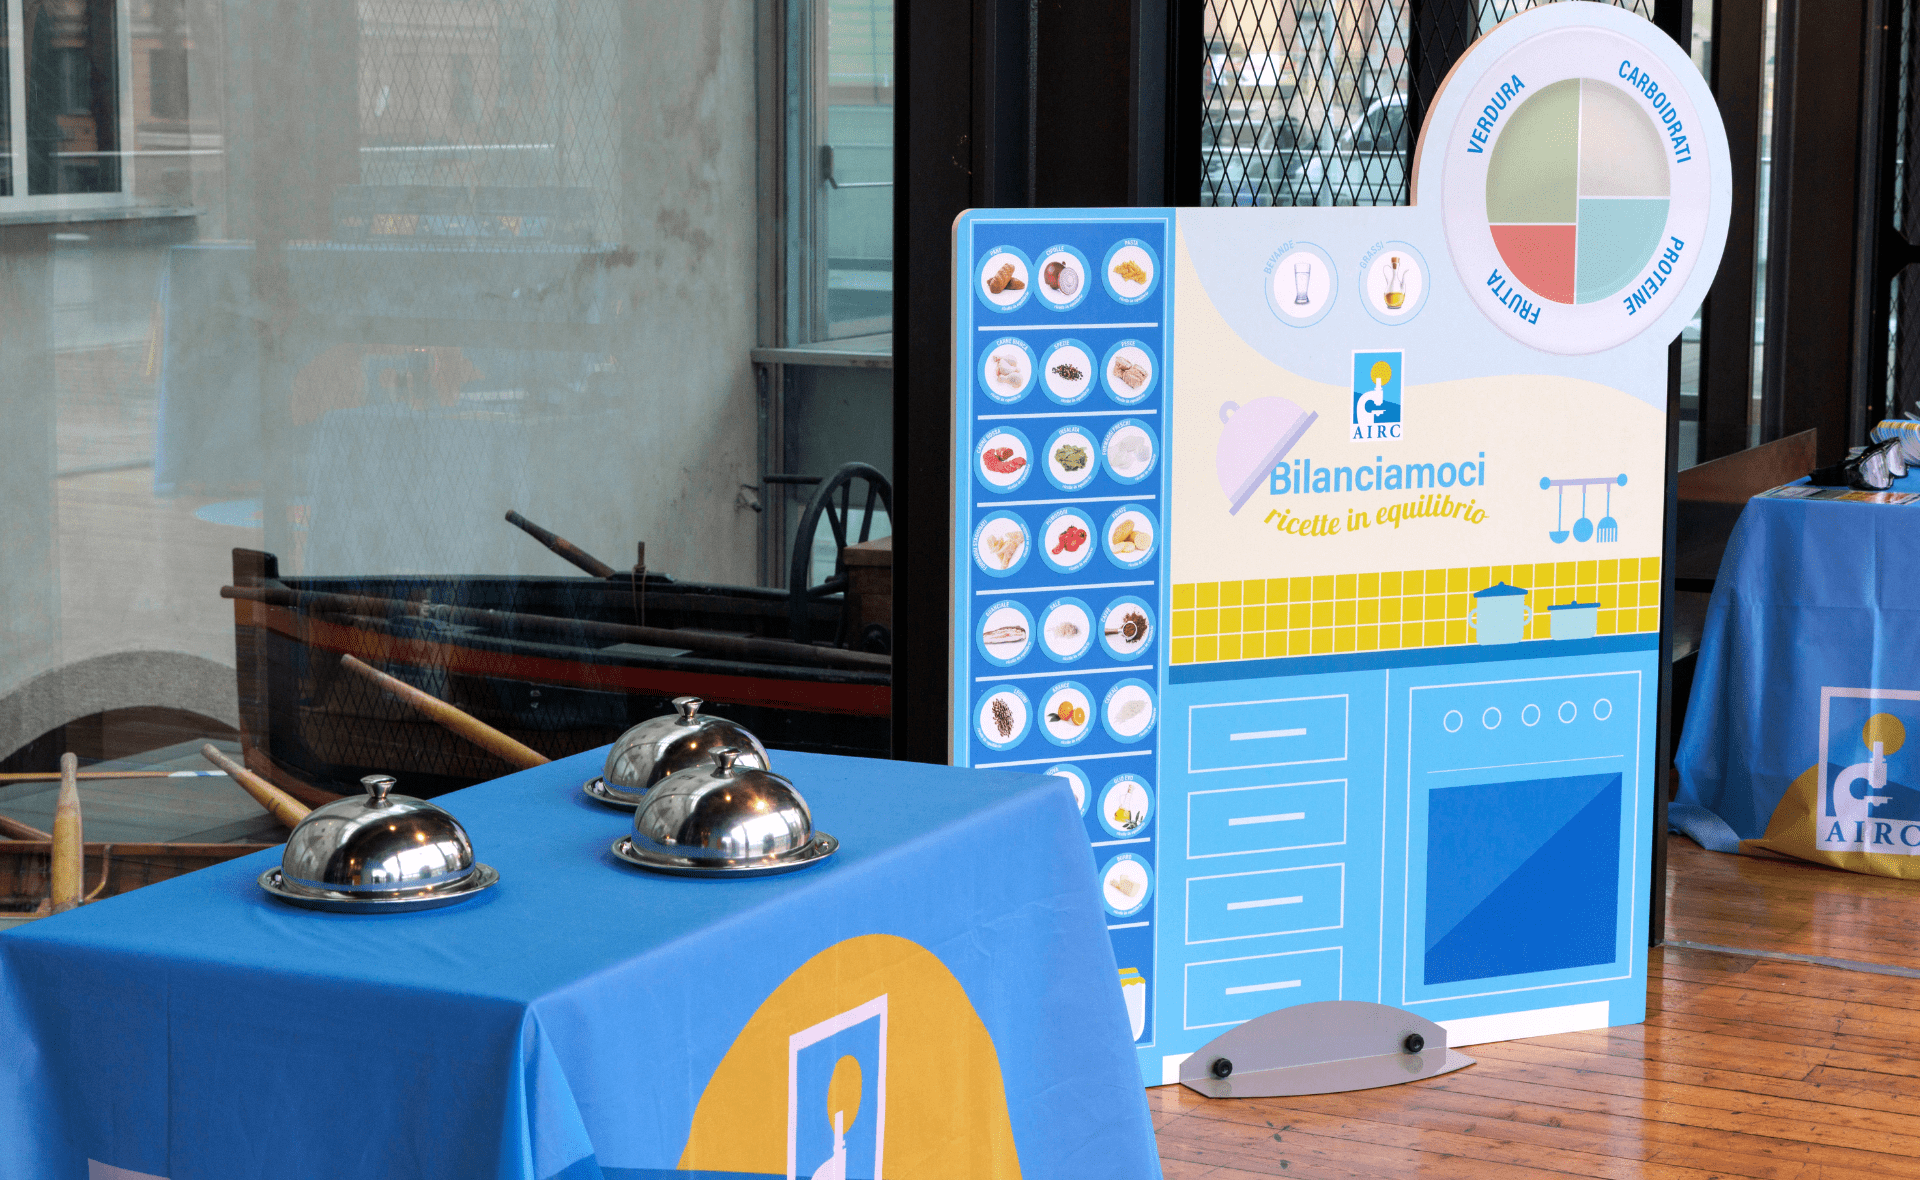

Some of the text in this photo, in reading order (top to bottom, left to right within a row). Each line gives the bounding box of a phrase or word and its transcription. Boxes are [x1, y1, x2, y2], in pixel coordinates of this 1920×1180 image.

[1467, 74, 1526, 154] VERDURA
[1618, 60, 1692, 164] CARBOIDRATI
[1263, 239, 1295, 275] BEVANDE
[1359, 241, 1385, 270] GRASSI
[1623, 236, 1685, 316] PROTEINE
[1486, 268, 1541, 325] FRUTTA
[1352, 423, 1402, 440] AIRC
[1270, 451, 1485, 495] Bilanciamoci
[1263, 493, 1490, 537] ricette in equilibrio
[1825, 820, 1920, 847] AIRC
